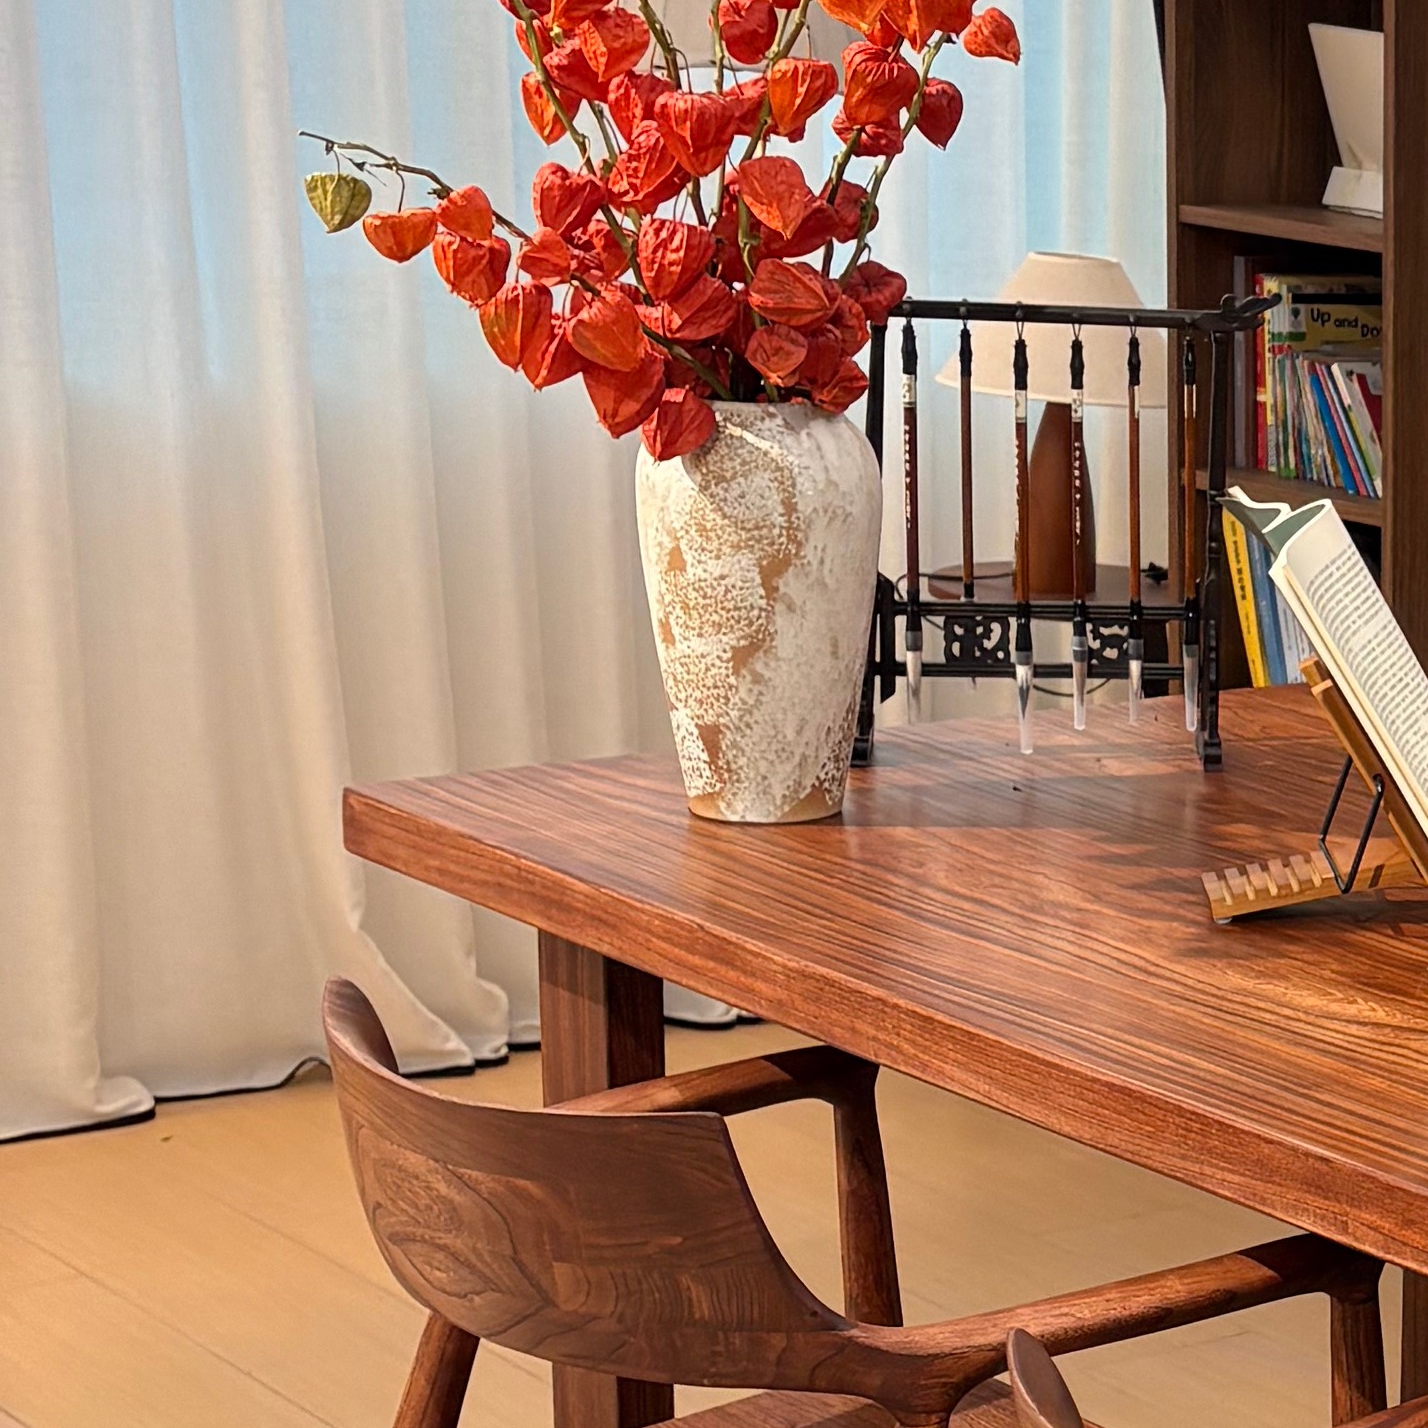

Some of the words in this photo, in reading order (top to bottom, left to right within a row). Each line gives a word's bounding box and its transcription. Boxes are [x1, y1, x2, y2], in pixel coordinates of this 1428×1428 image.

[1310, 308, 1331, 326] Up
[1334, 317, 1358, 329] and
[1360, 323, 1382, 338] Do
